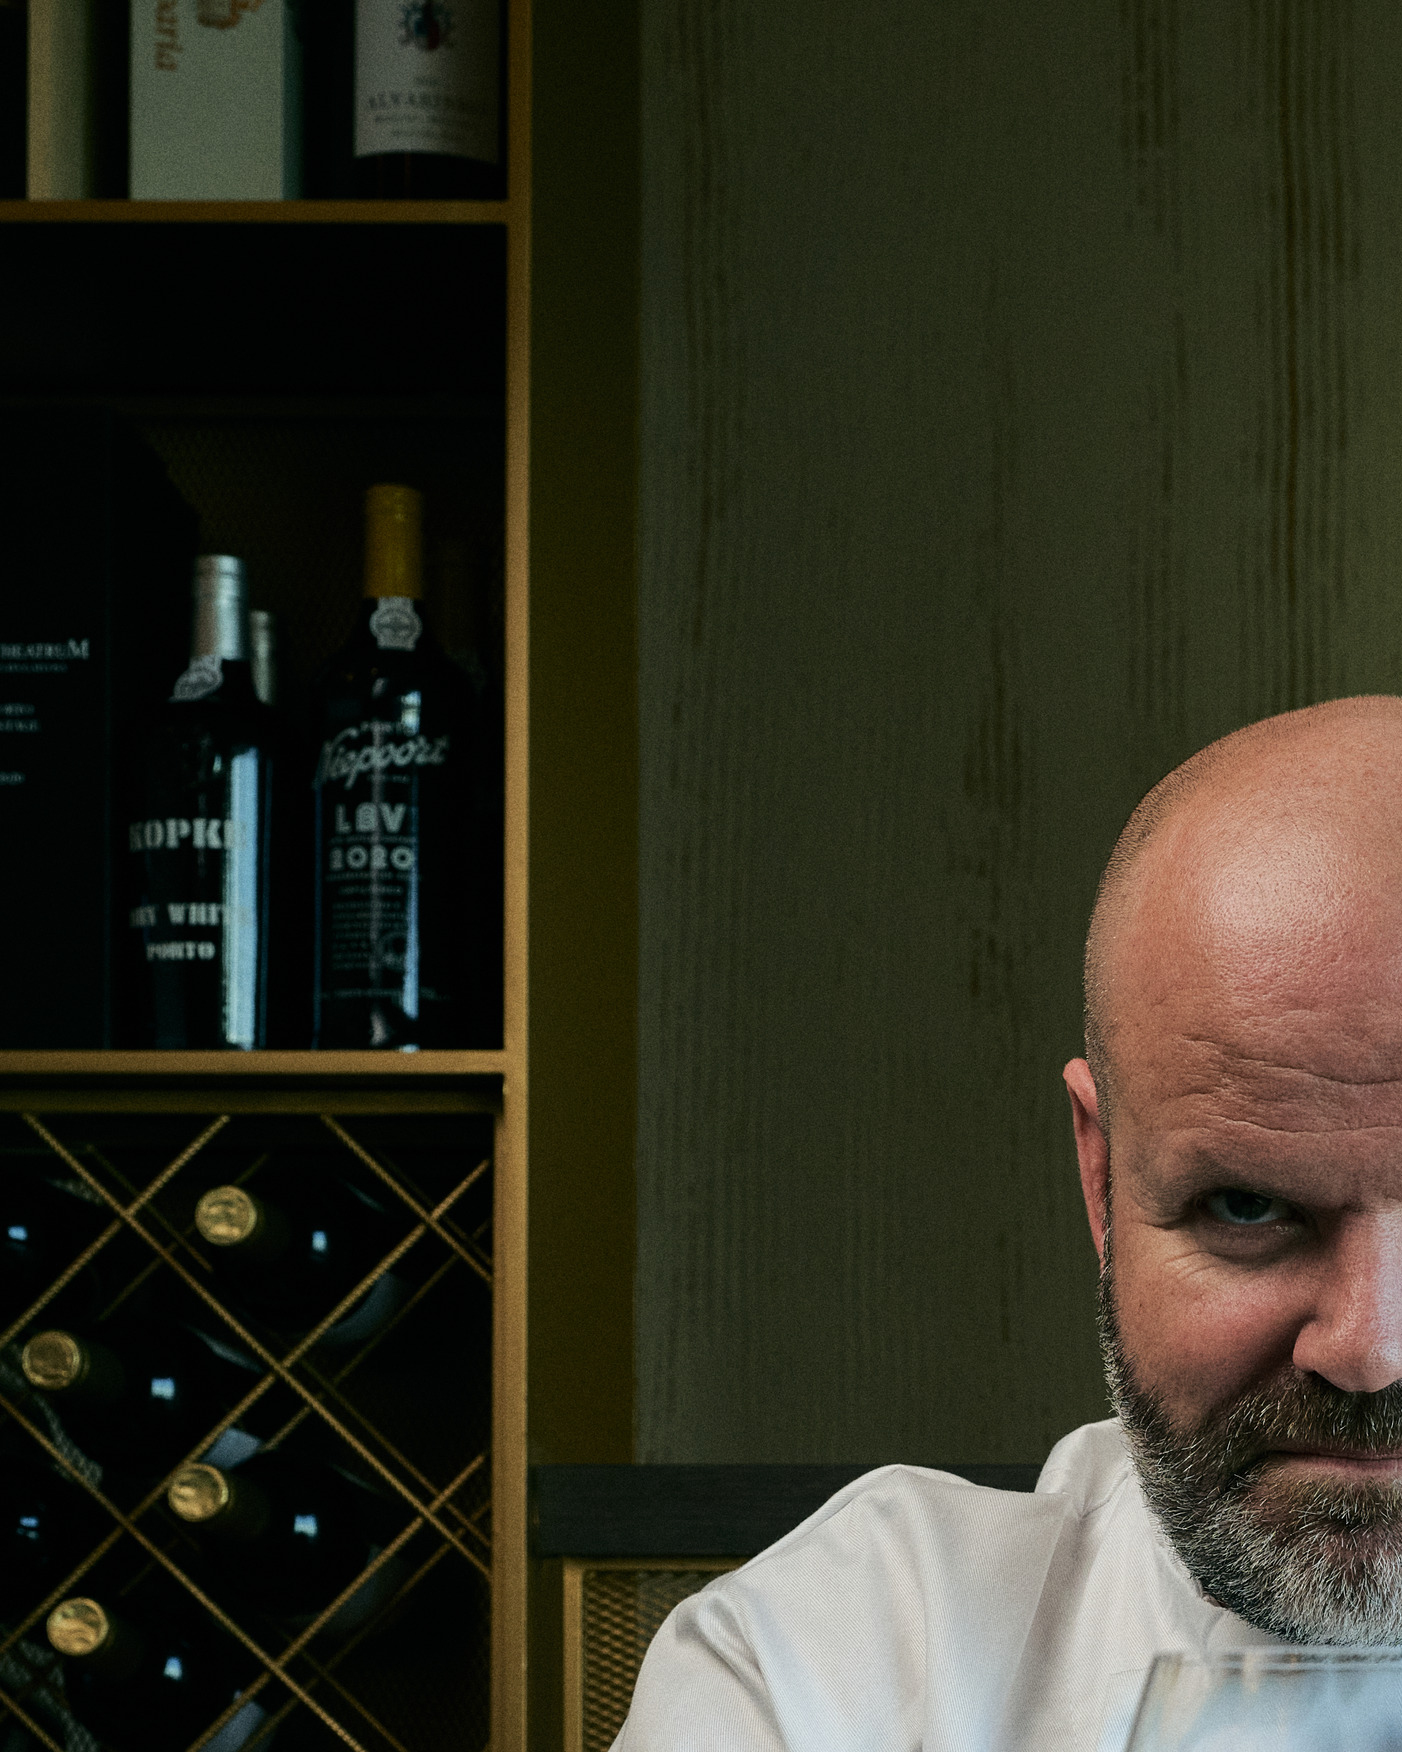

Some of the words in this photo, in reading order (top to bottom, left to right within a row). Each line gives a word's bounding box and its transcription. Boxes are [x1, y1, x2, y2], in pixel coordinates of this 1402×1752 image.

[0, 637, 90, 661] HEATRUM
[334, 801, 407, 834] LBV
[166, 901, 240, 927] WHIT
[145, 940, 217, 963] PORTO
